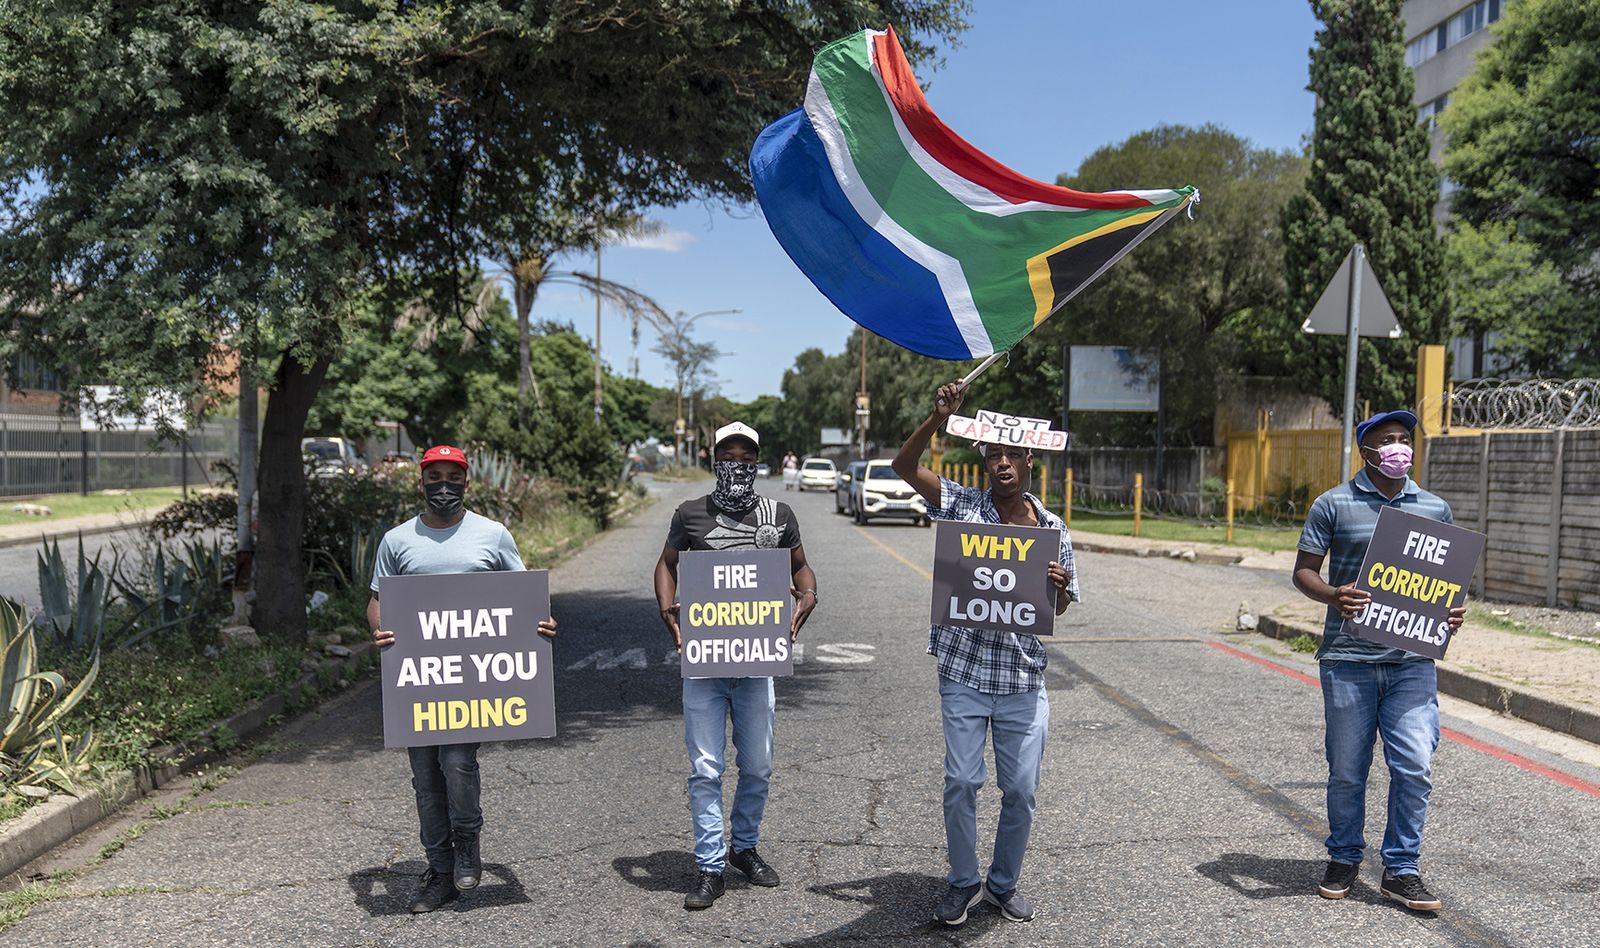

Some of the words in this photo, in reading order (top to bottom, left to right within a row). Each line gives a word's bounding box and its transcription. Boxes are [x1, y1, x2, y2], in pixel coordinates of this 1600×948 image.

[950, 418, 1065, 448] CAPTURED
[979, 412, 1048, 430] NOT
[960, 534, 1036, 562] WHY
[1402, 530, 1451, 566] FIRE
[713, 563, 758, 590] FIRE
[972, 566, 1017, 592] SO
[1367, 562, 1462, 609] CORRUPT
[417, 607, 514, 641] WHAT
[688, 600, 785, 628] CORRUPT
[949, 596, 1037, 628] LONG
[685, 636, 789, 665] OFFICIALS
[396, 654, 464, 688] ARE
[469, 650, 538, 683] YOU
[413, 696, 528, 732] HIDING
